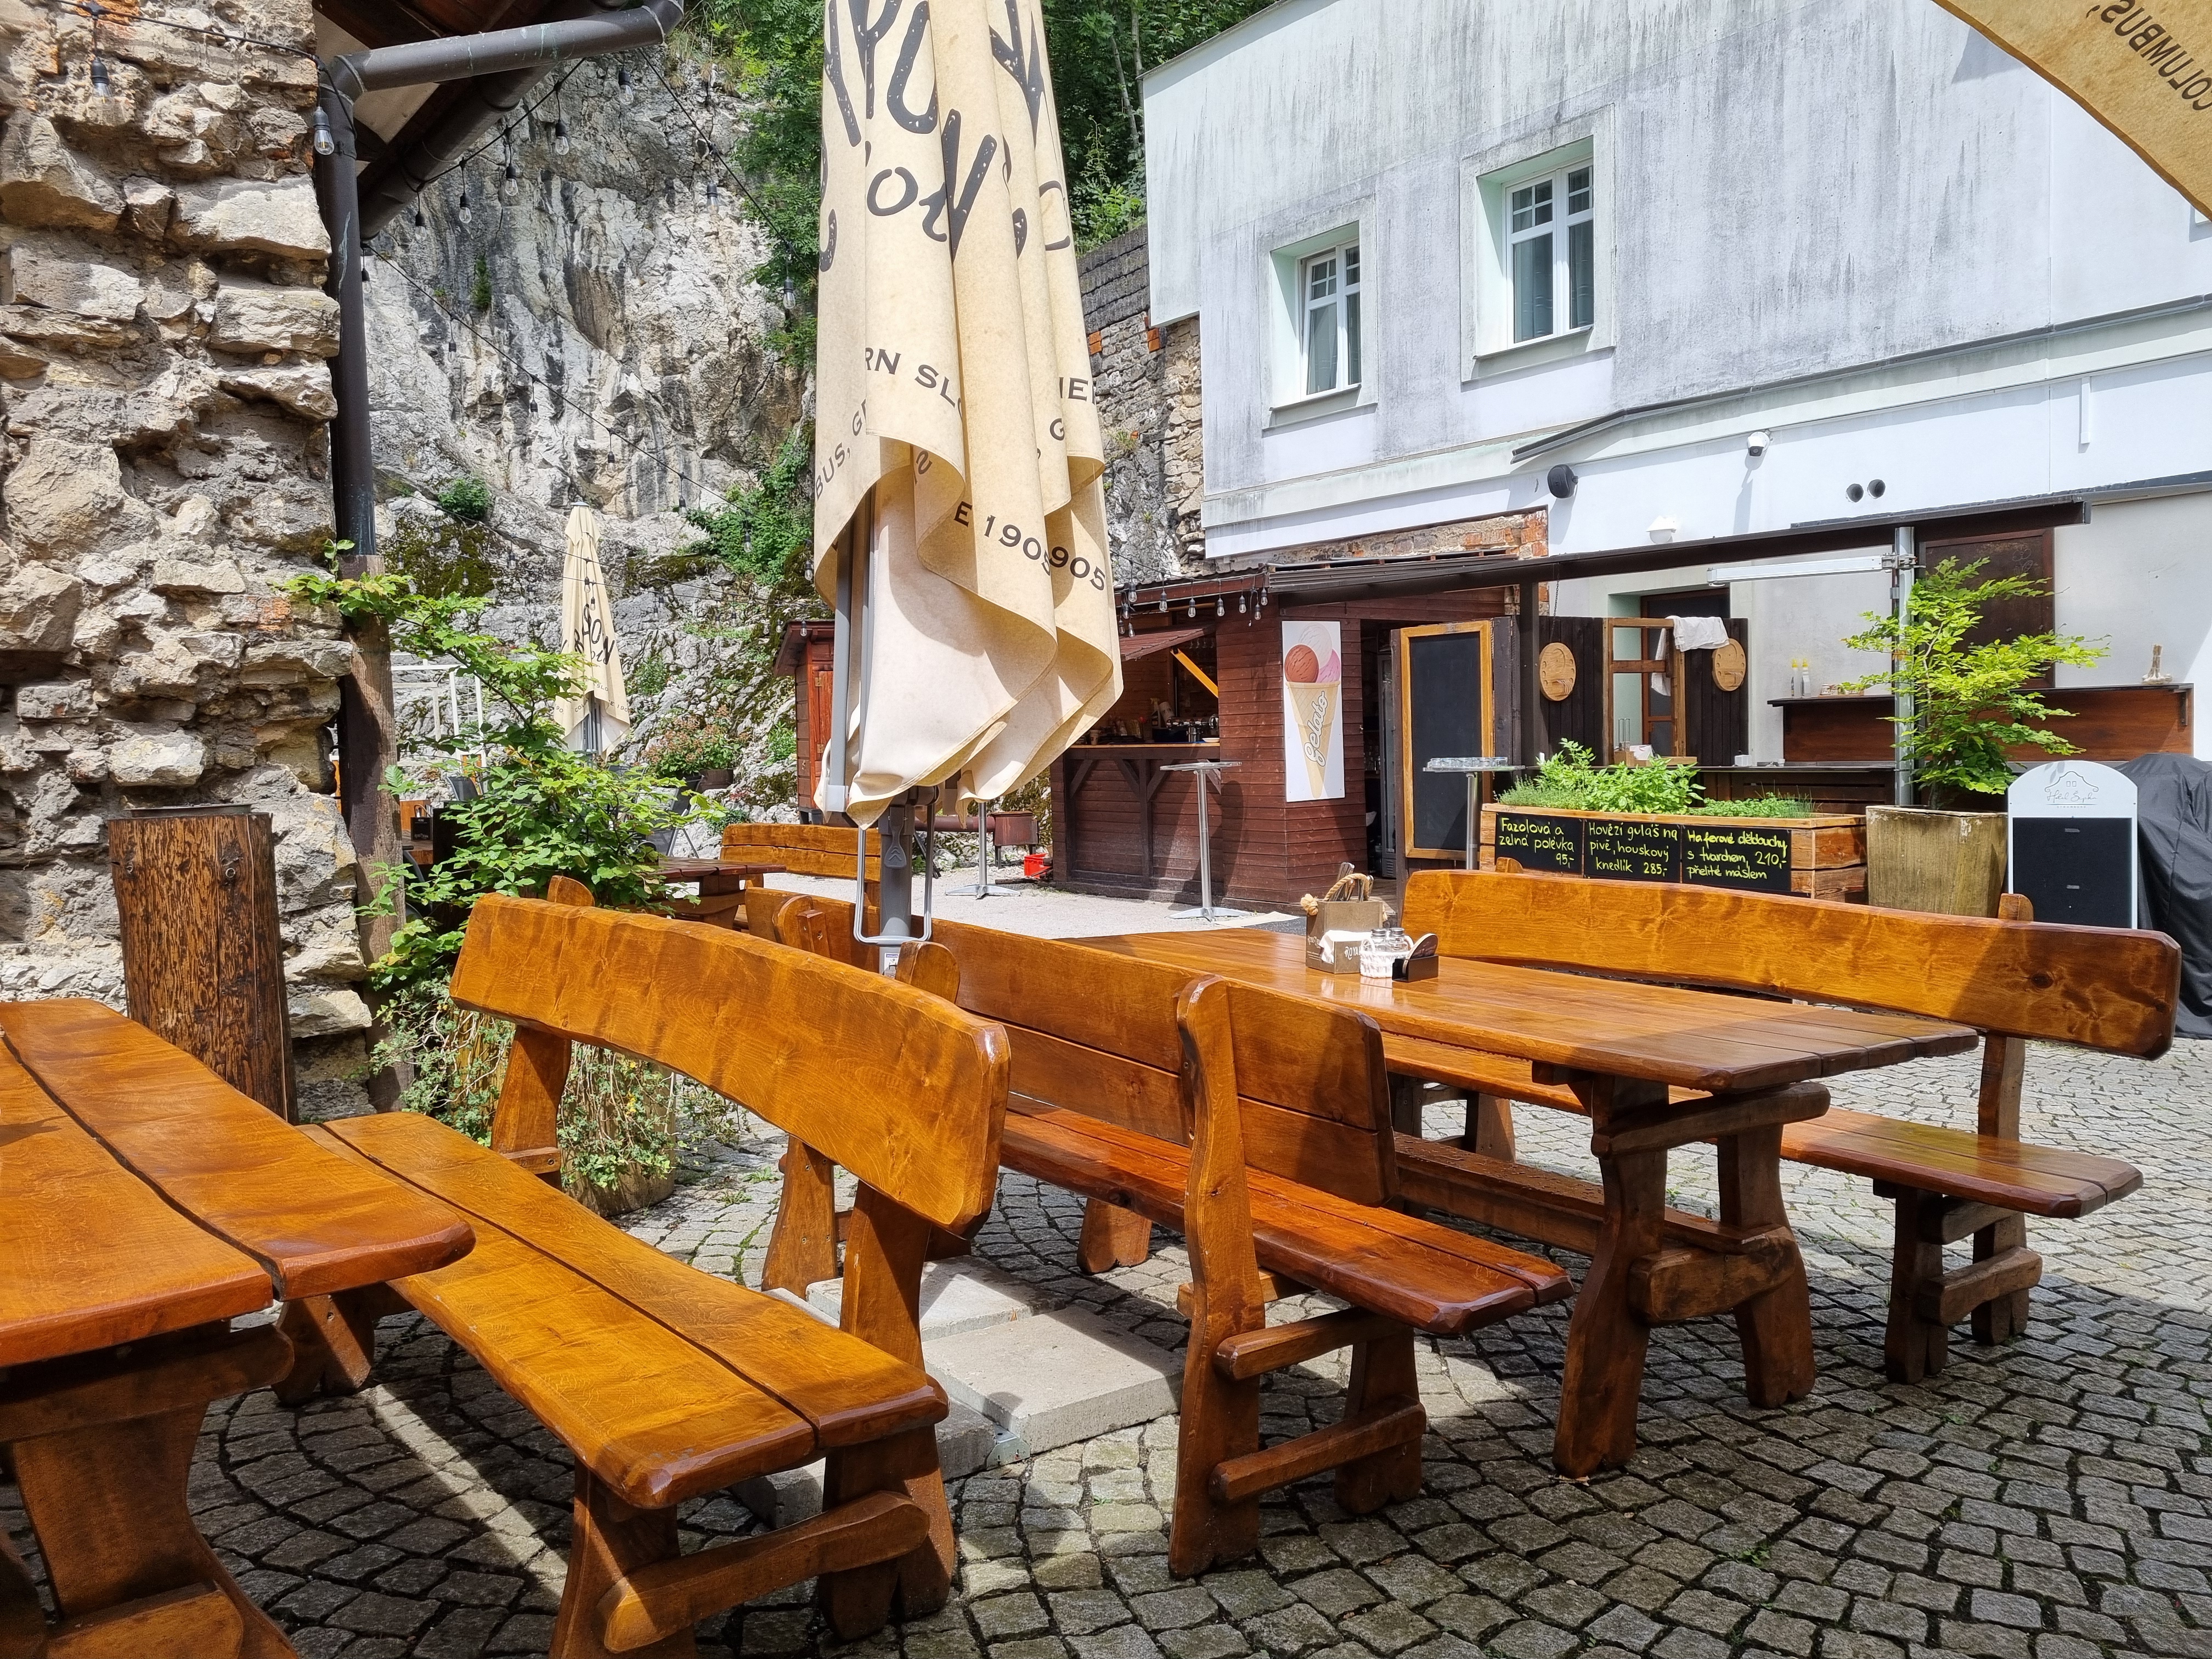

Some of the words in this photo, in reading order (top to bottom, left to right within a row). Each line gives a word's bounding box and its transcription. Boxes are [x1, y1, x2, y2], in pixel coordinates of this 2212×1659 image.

[815, 442, 850, 500] BUS,
[1050, 546, 1106, 591] 905
[617, 704, 628, 712] 190
[1501, 817, 1551, 835] Fazolová
[1555, 826, 1564, 835] a
[1627, 824, 1660, 841] guláš
[1663, 828, 1678, 841] na
[1499, 833, 1529, 847] zelná
[1534, 836, 1575, 853] polévka
[1617, 840, 1669, 862] houskový
[1688, 850, 1695, 860] s
[1725, 865, 1767, 879] máslem
